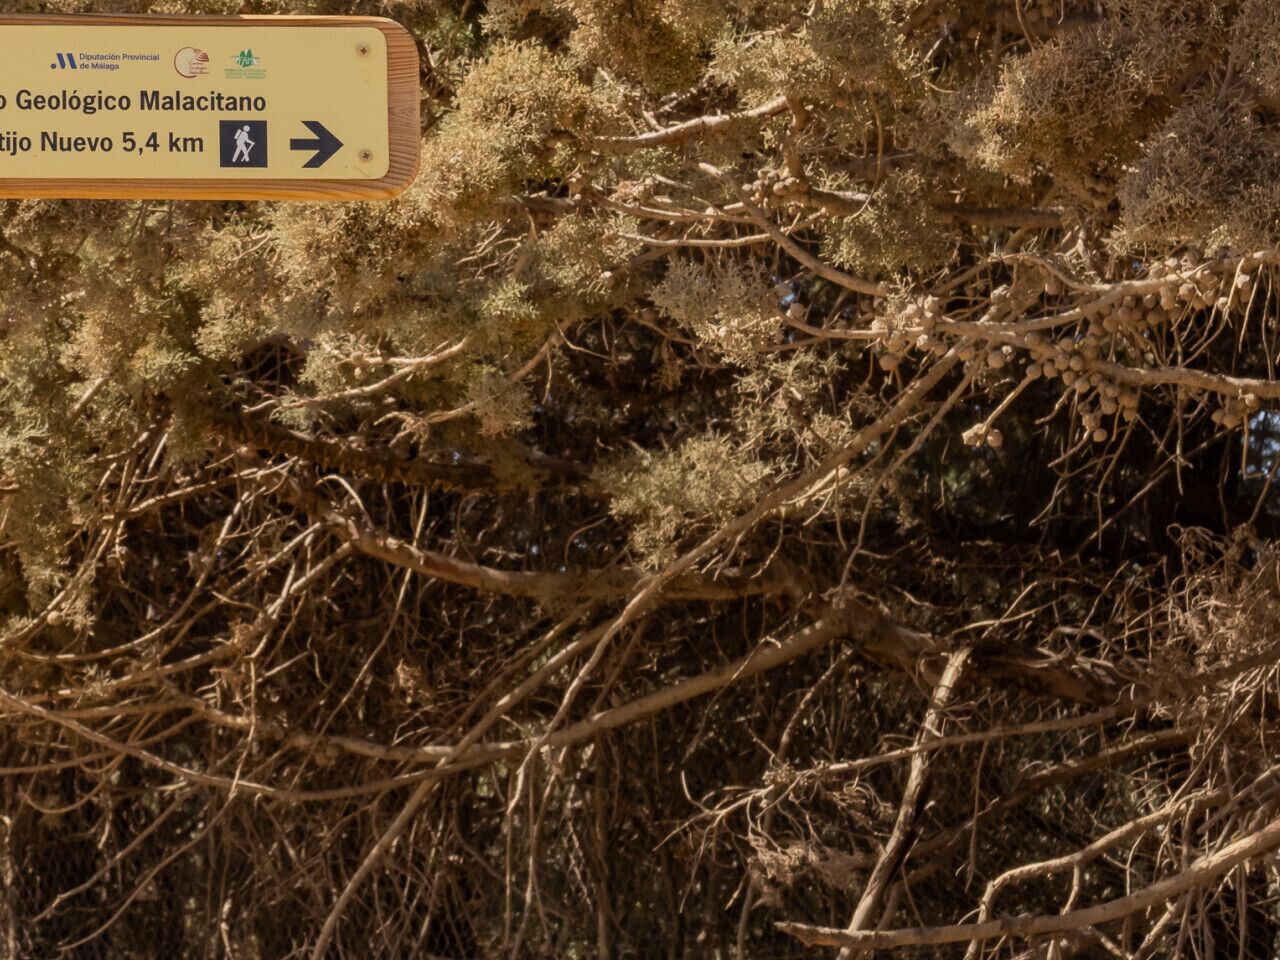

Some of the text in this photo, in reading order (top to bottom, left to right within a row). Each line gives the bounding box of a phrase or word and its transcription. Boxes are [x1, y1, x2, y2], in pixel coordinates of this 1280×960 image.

[79, 52, 160, 61] Diputación Provincial
[79, 61, 120, 72] de Málaga
[15, 88, 131, 115] Geológico
[140, 90, 267, 112] Malacitano
[40, 131, 113, 153] Nuevo
[122, 132, 160, 156] 5,4
[168, 130, 204, 153] km
